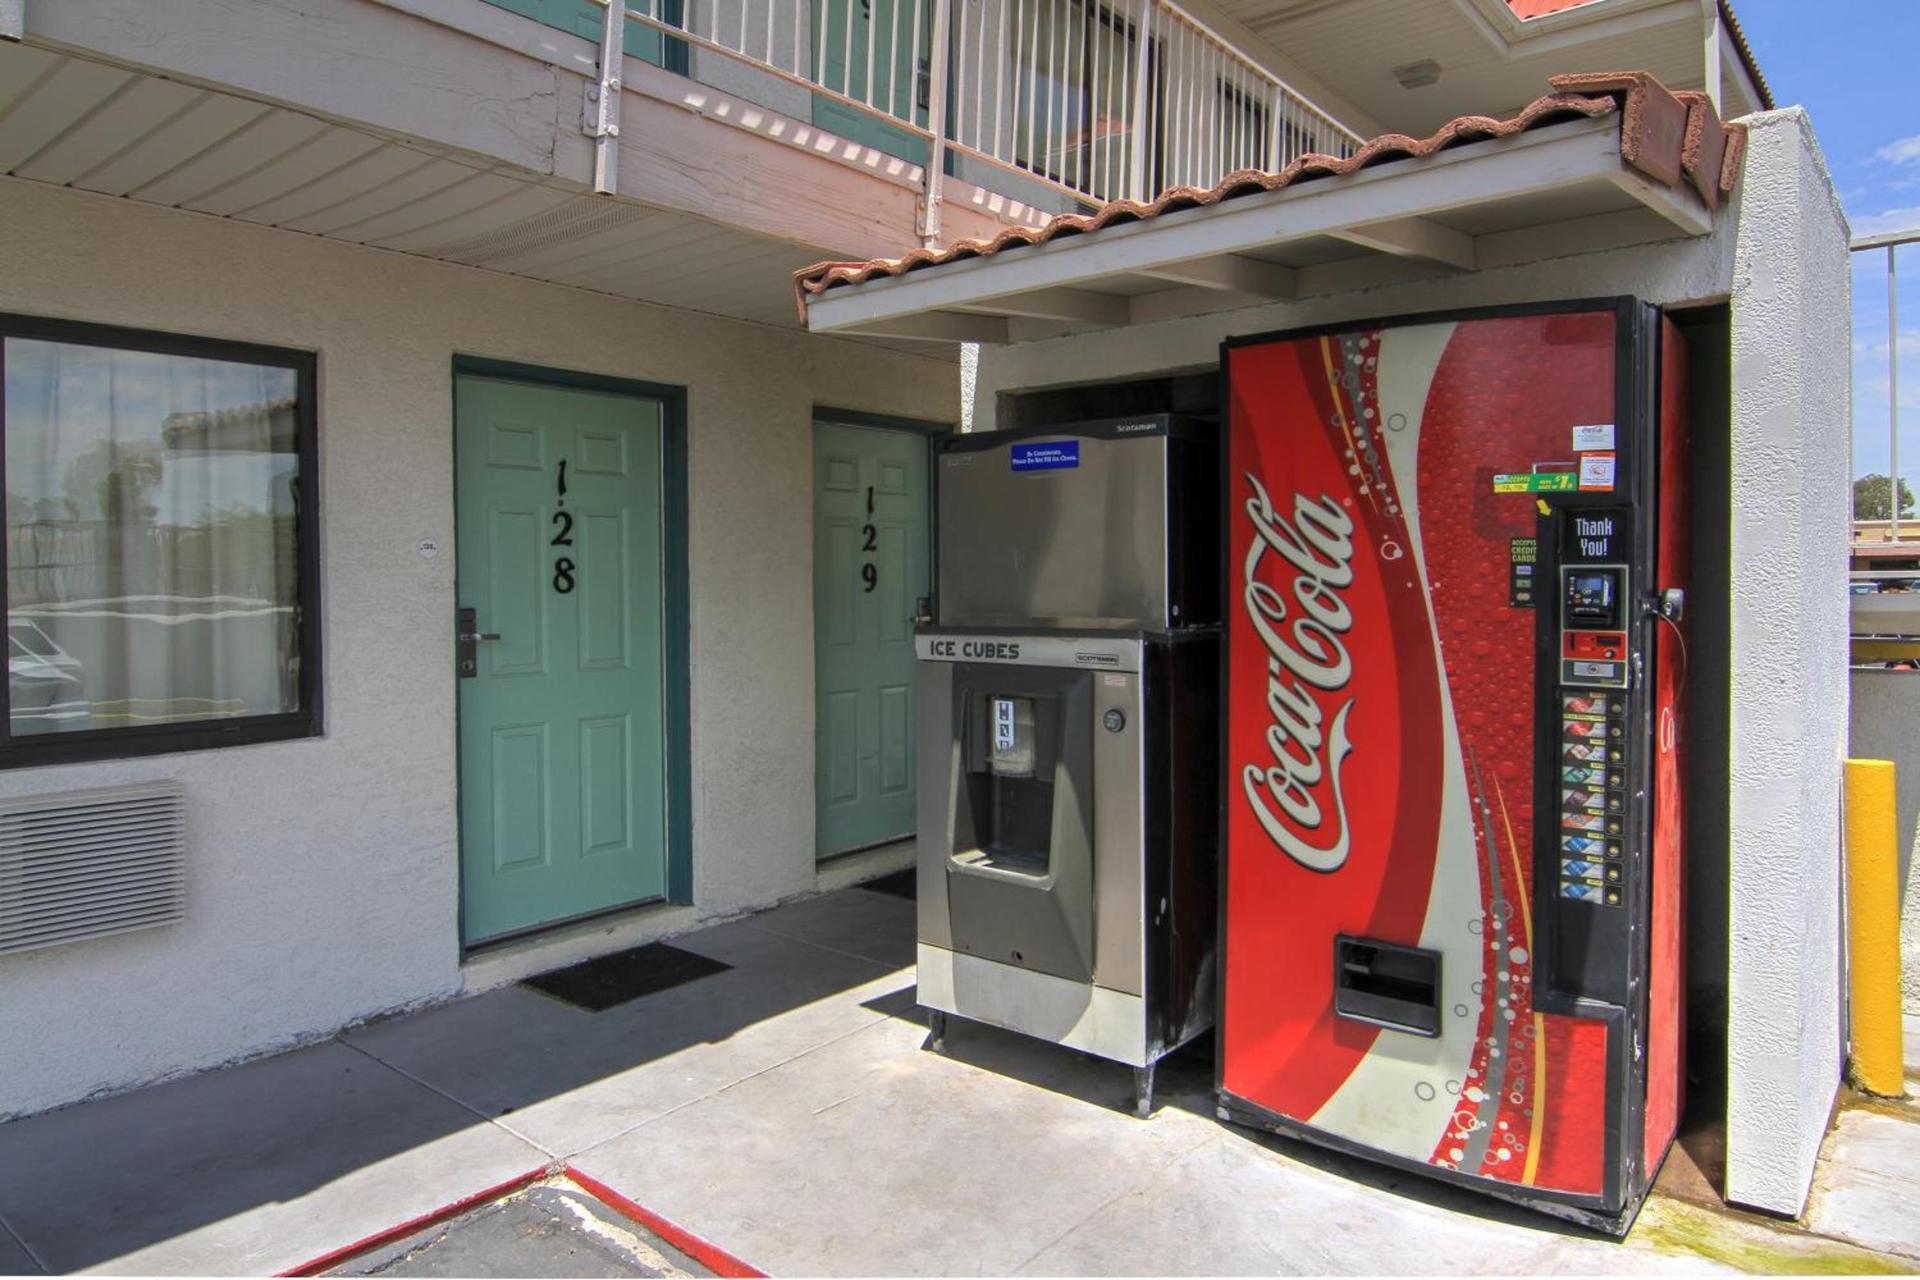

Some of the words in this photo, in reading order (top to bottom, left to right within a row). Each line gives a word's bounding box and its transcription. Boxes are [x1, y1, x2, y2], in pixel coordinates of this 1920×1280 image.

[1116, 423, 1157, 432] Scotsman
[551, 459, 575, 594] 128
[1576, 517, 1612, 536] Thank
[862, 486, 877, 593] 129
[1580, 538, 1607, 556] You!
[1512, 554, 1536, 562] CARDS
[930, 641, 955, 656] ICE
[963, 642, 1019, 659] CUBES
[1243, 472, 1355, 872] Coca-Cola
